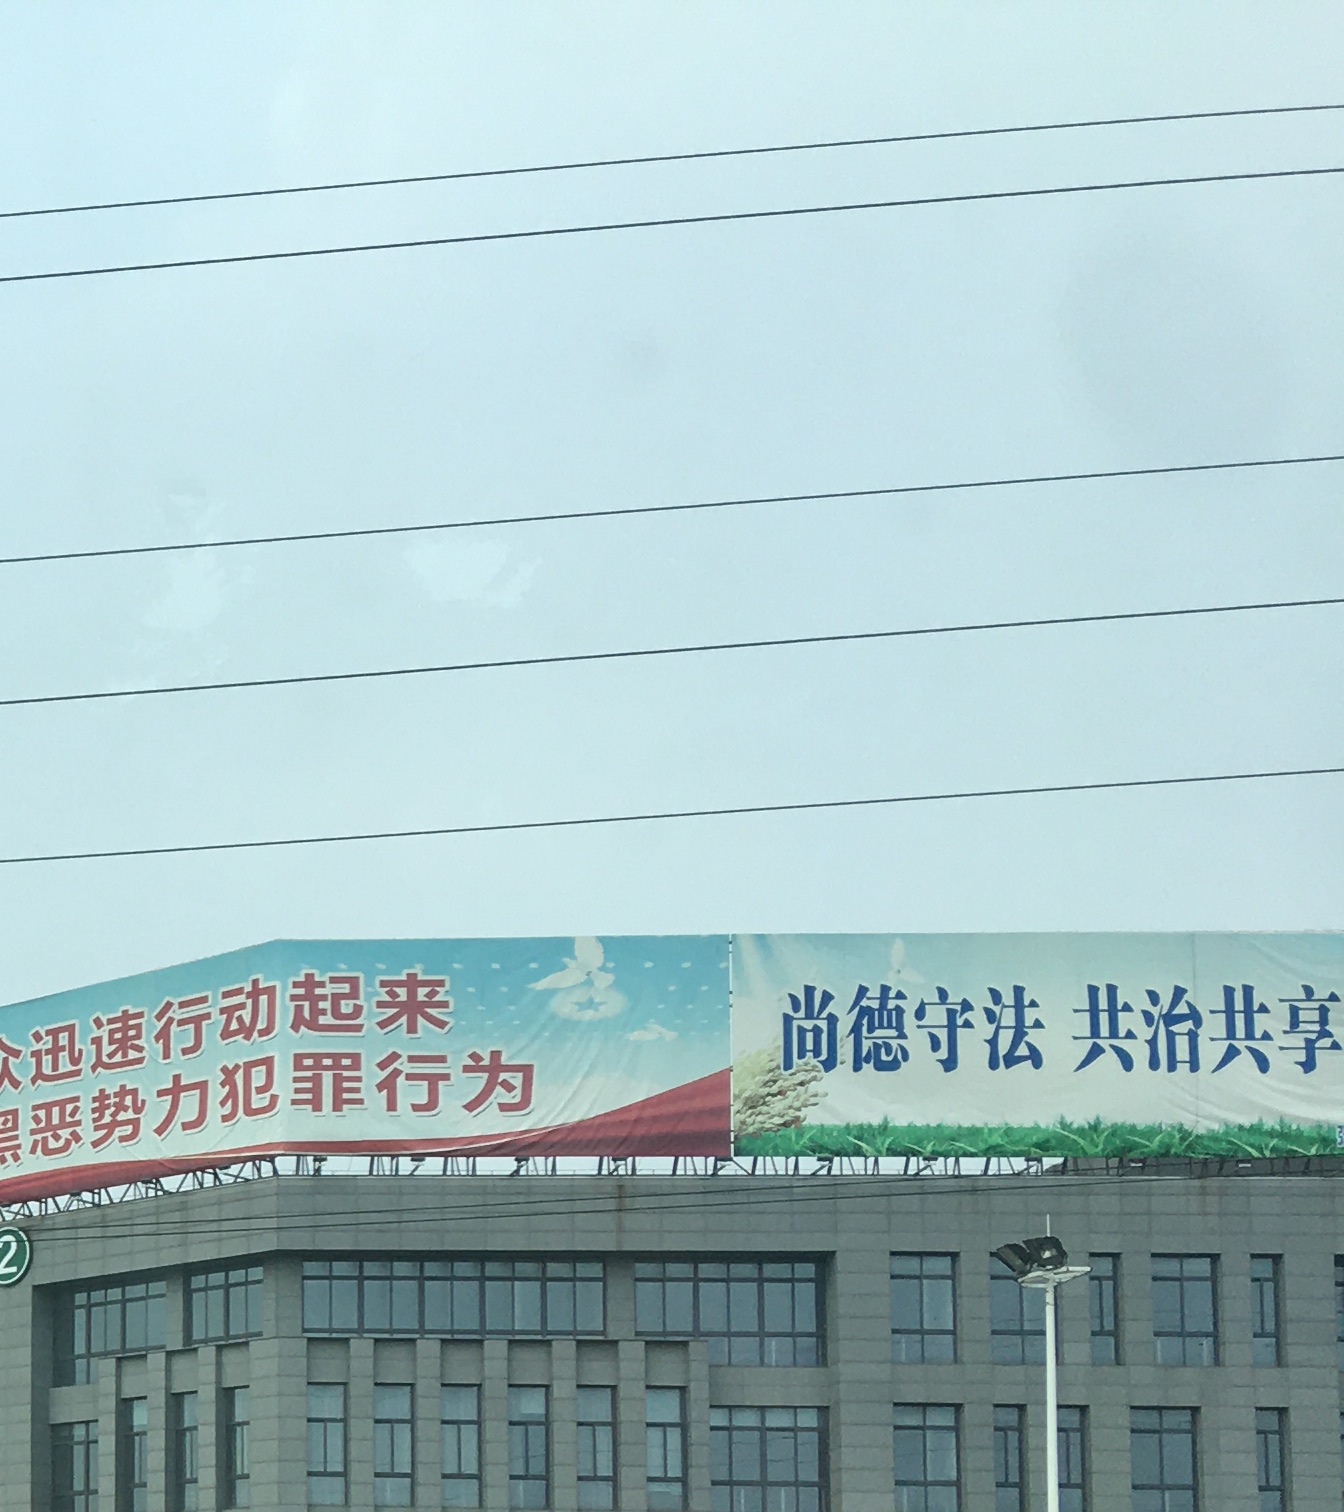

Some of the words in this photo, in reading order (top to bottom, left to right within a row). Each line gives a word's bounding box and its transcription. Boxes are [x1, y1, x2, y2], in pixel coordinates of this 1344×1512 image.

[781, 984, 1046, 1073] 尚德守法
[1072, 984, 1344, 1074] 共治共享
